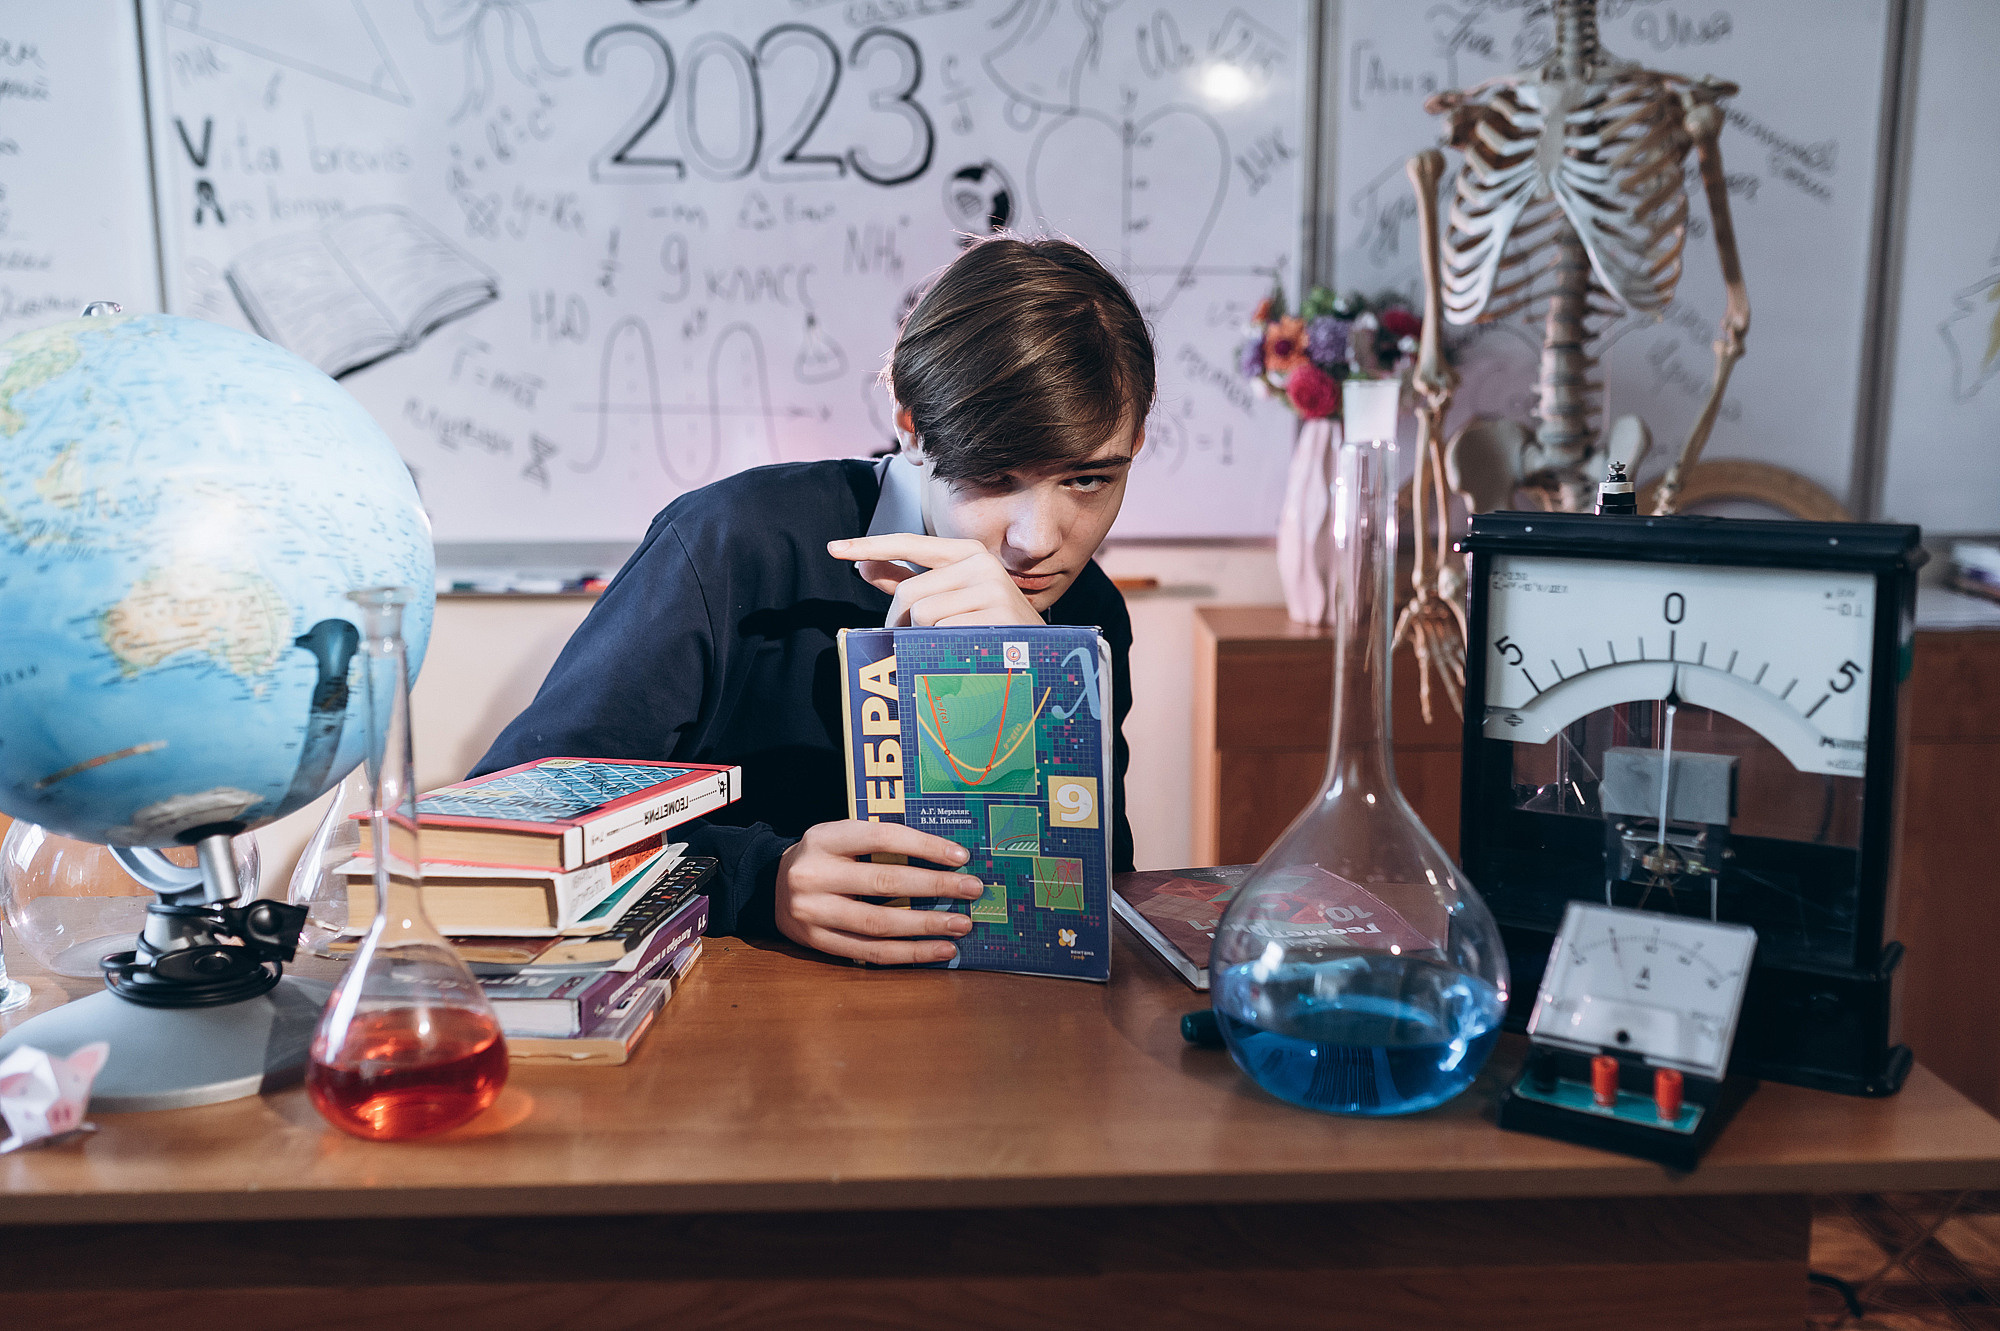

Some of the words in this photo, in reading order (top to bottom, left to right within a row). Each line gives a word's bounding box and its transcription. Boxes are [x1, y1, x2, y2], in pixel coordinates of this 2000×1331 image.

[584, 22, 935, 186] 2023
[658, 231, 692, 304] 9
[1663, 592, 1686, 625] 0
[1493, 635, 1524, 667] 5
[1829, 659, 1864, 695] 5
[644, 795, 689, 826] ГЕОМЕТРИЯ
[1055, 783, 1094, 822] 9
[940, 816, 972, 825] Поляков
[697, 913, 707, 931] 11
[1325, 904, 1375, 922] 10
